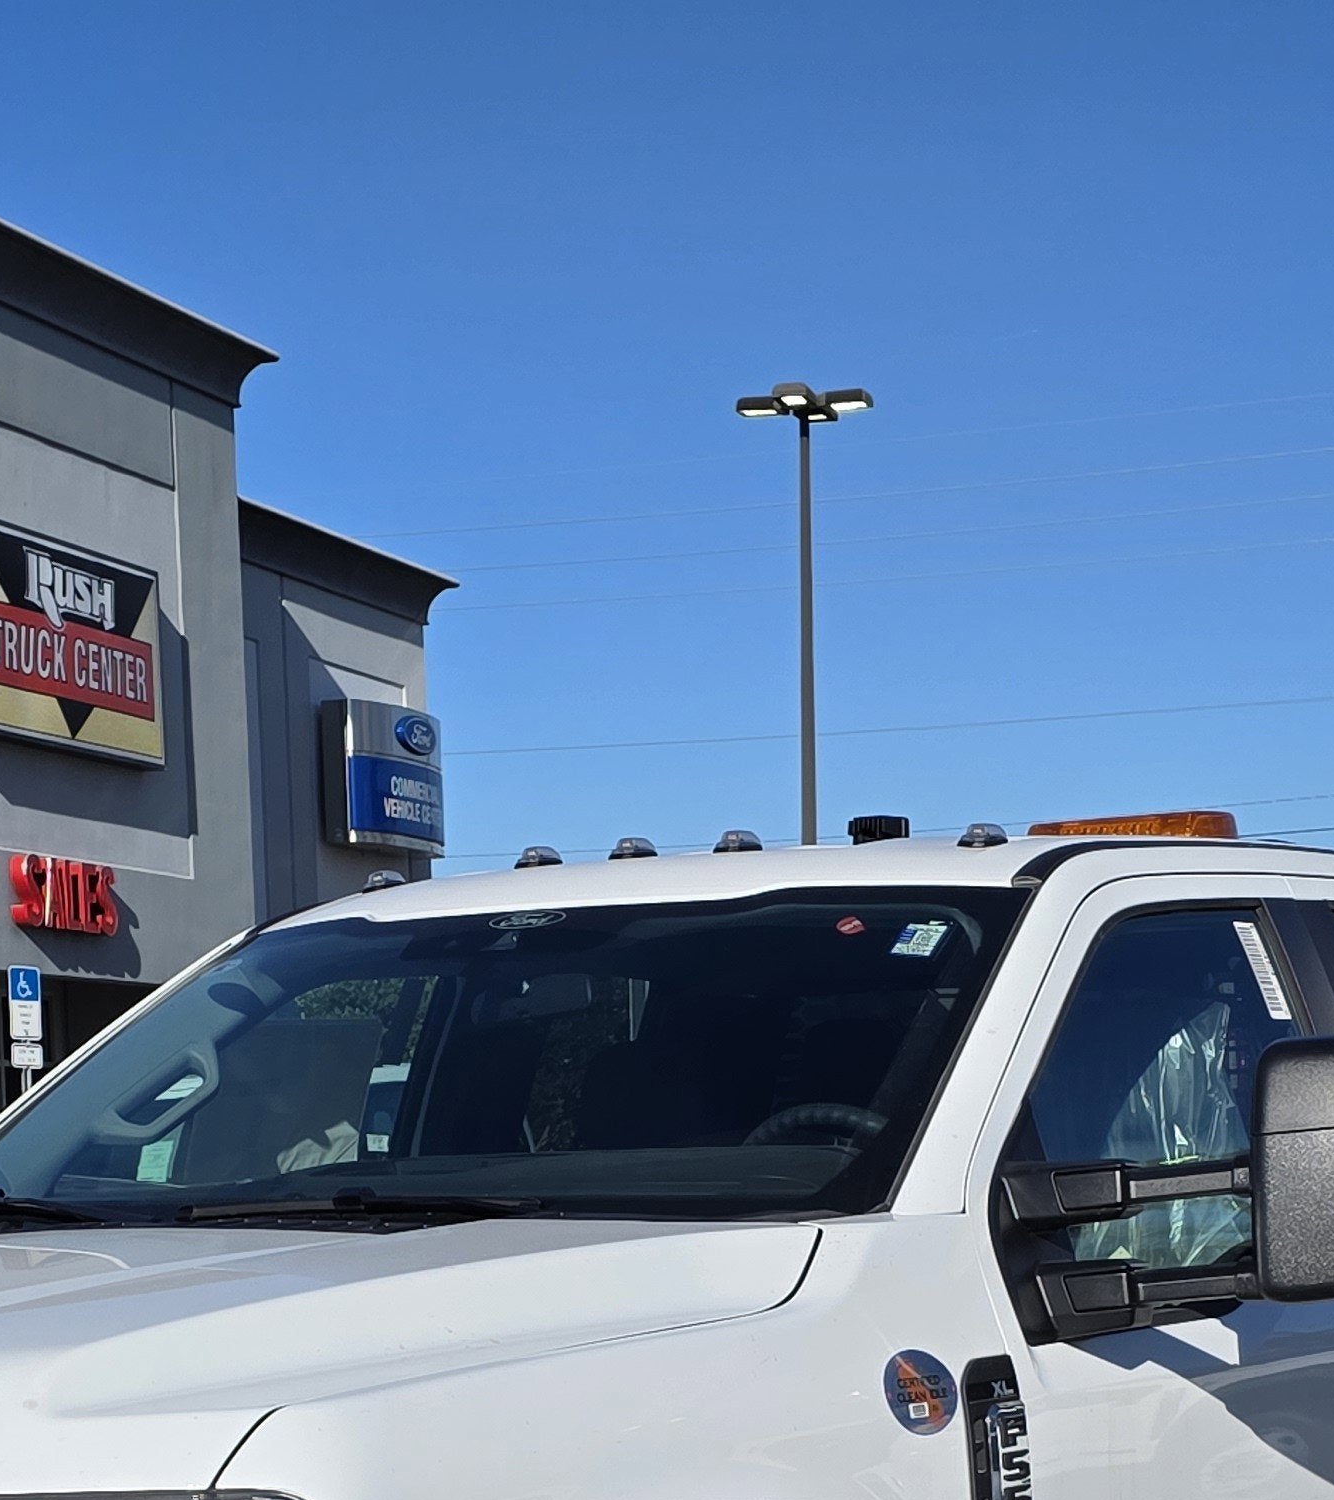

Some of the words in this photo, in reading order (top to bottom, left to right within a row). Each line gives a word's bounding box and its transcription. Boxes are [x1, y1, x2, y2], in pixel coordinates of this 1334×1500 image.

[23, 545, 116, 631] RUSH
[74, 638, 148, 704] CENTER
[9, 854, 119, 937] SALES
[991, 1381, 1015, 1397] XL
